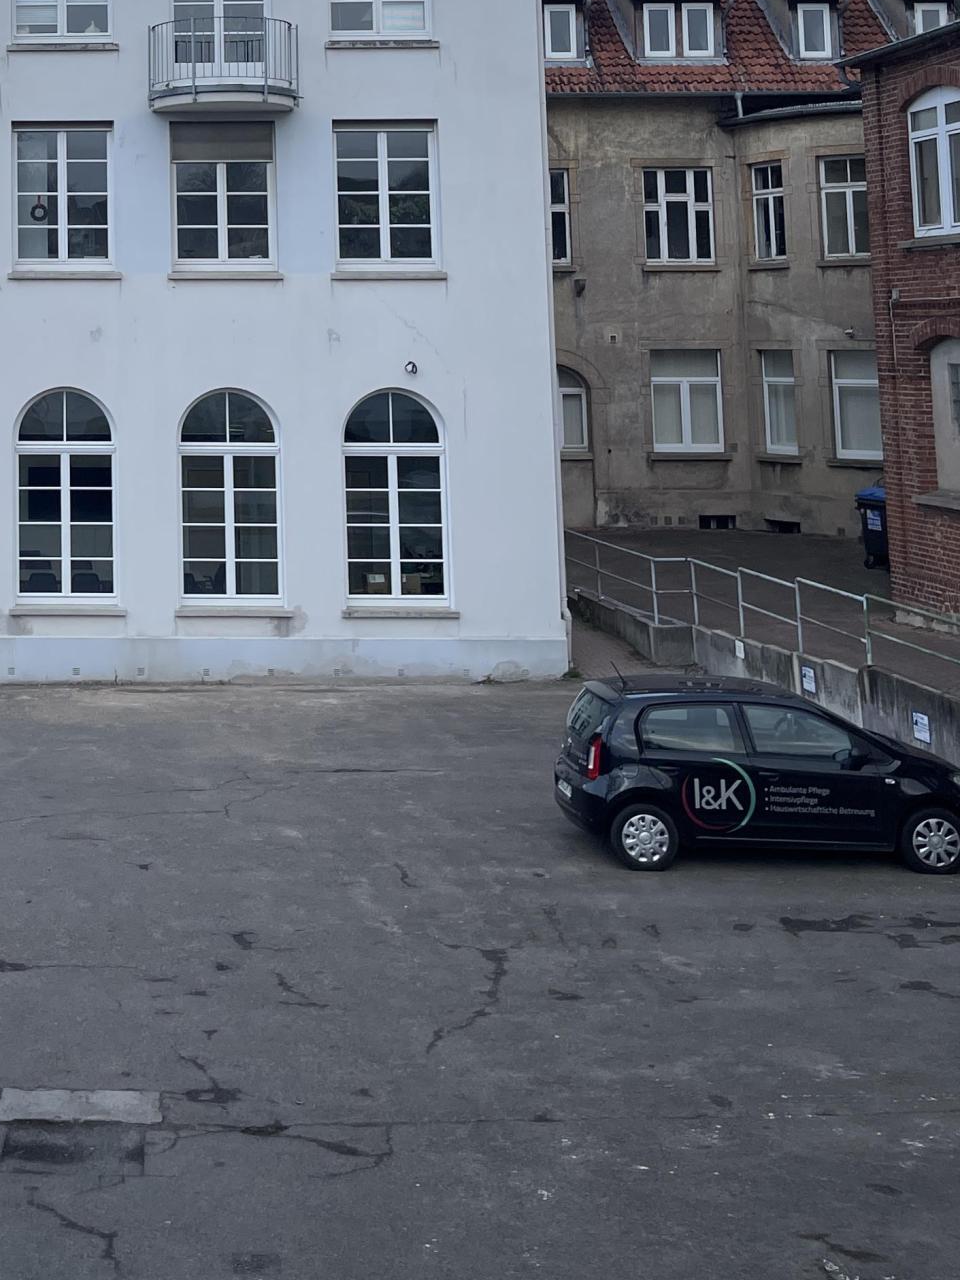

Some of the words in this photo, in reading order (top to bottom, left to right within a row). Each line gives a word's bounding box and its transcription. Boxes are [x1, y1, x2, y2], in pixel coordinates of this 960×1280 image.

[694, 778, 744, 811] I&K
[769, 785, 807, 794] Ambulante
[808, 786, 830, 796] Pflege
